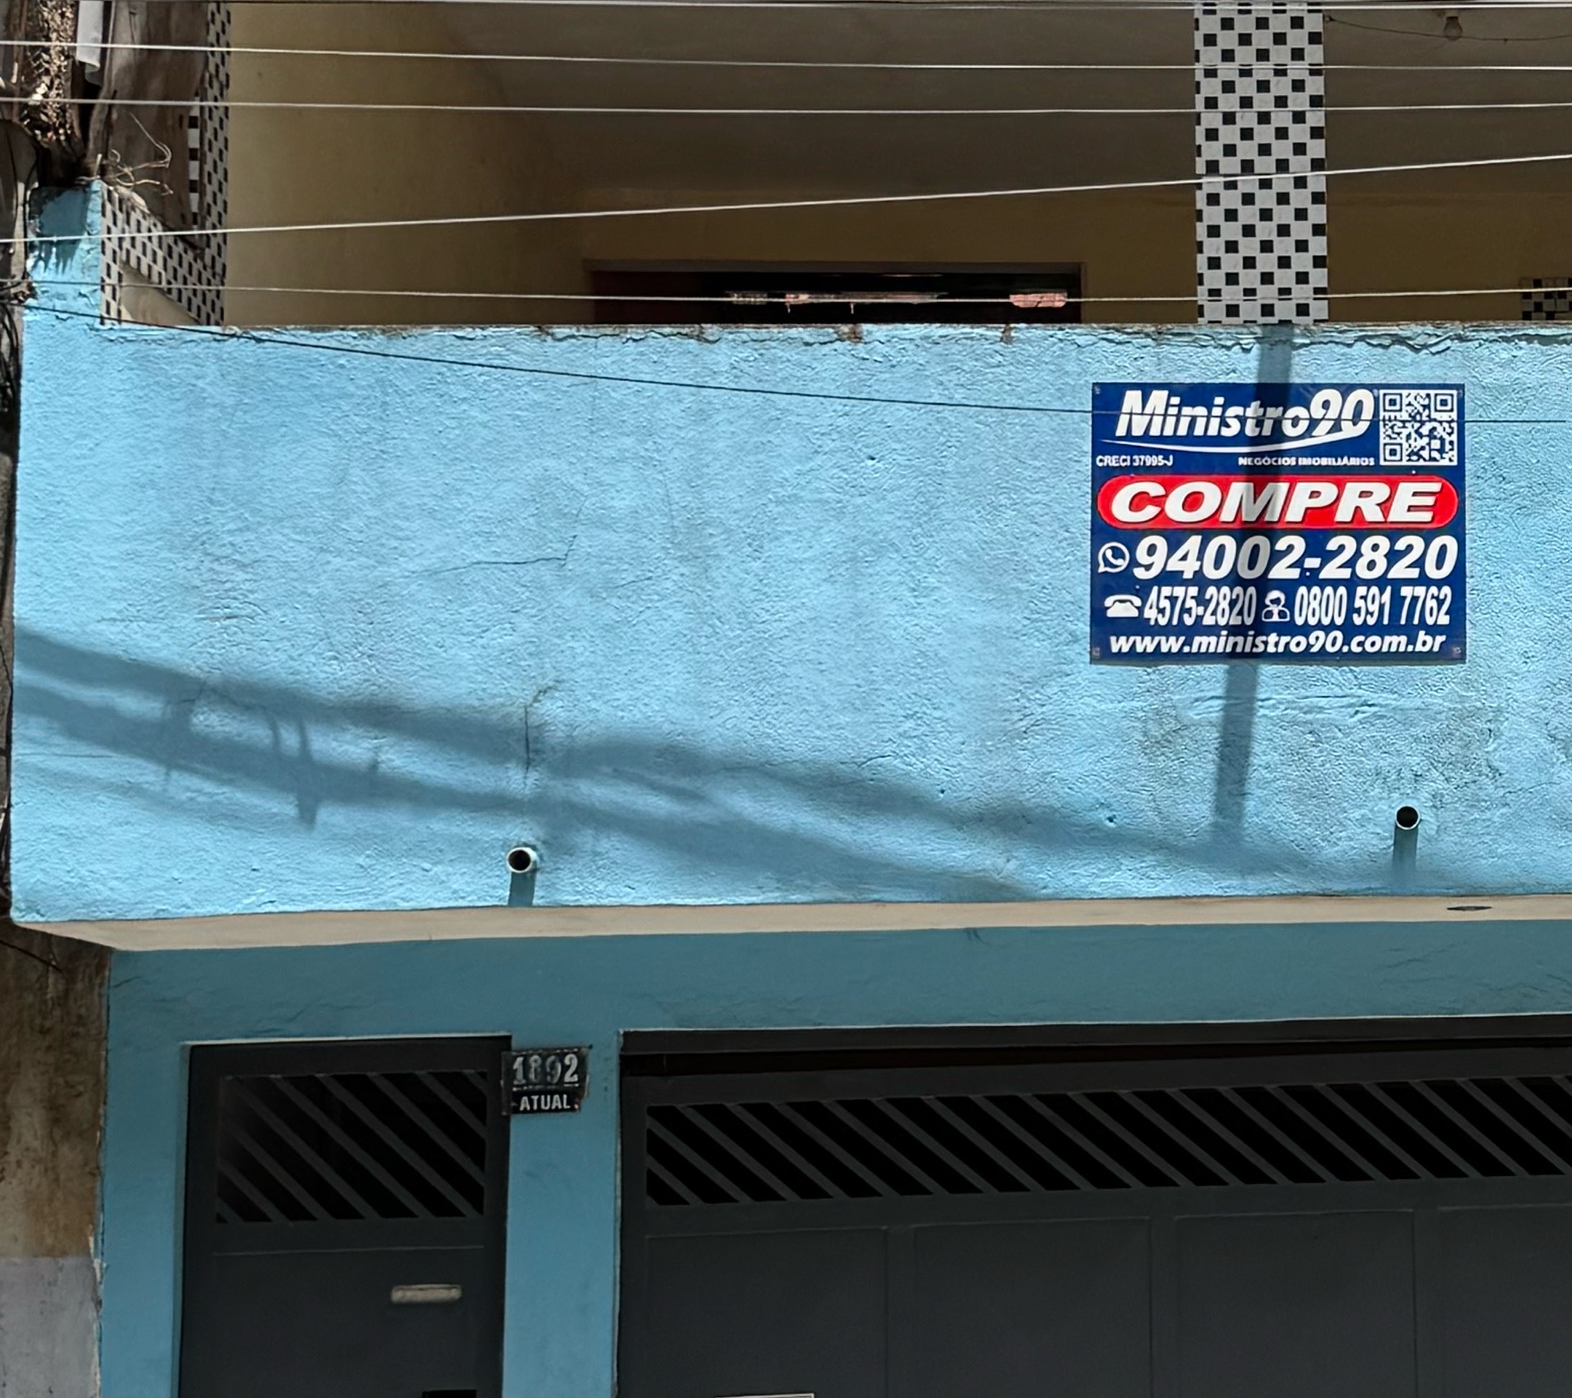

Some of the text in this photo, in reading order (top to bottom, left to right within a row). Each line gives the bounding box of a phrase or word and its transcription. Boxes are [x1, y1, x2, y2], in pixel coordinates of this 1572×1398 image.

[1115, 389, 1375, 437] Ministro90
[1096, 454, 1131, 467] CRECI
[1238, 455, 1296, 466] NEGÓCIOS
[1110, 481, 1443, 524] COMPRE
[1132, 535, 1458, 580] 94002-2820
[1143, 586, 1256, 626] 4575-2820
[1294, 586, 1451, 626] 0800 591 7762
[1109, 630, 1446, 655] www.ministro90.com.br
[519, 1094, 571, 1111] ATUAL
